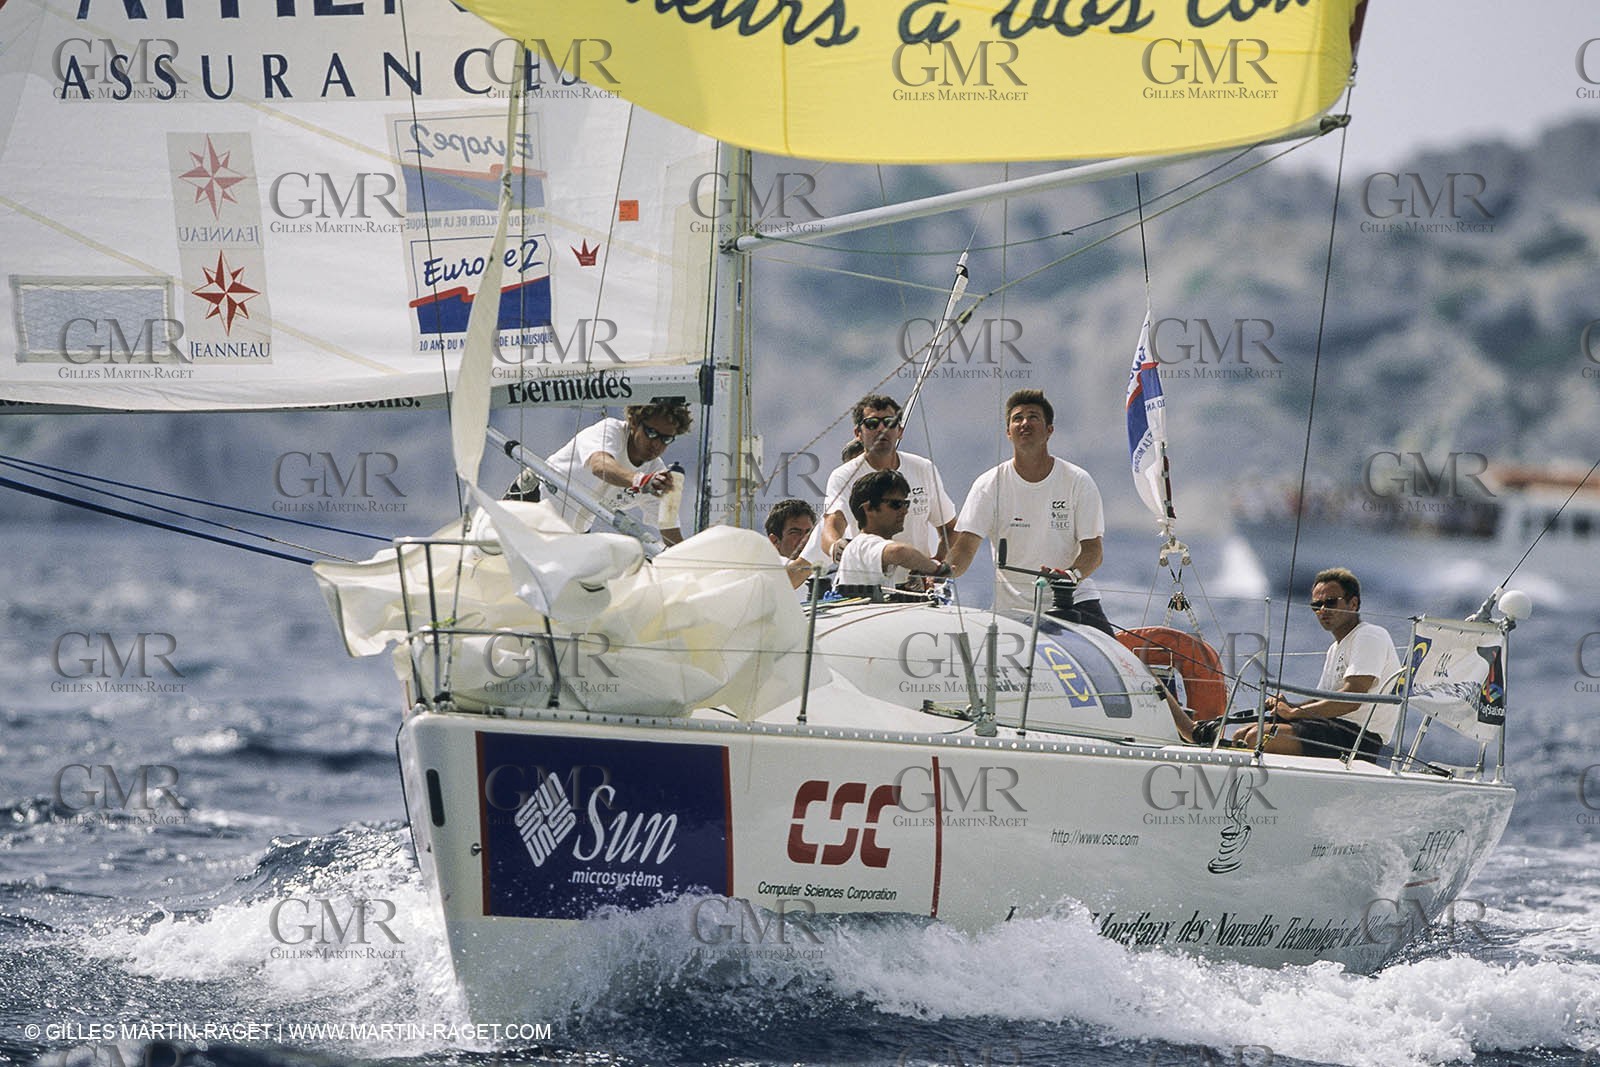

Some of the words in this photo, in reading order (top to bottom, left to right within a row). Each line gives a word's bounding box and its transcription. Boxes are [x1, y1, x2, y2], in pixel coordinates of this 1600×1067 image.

[423, 239, 544, 287] Euroe2
[190, 341, 270, 360] JEANNEAU
[420, 340, 427, 351] 10
[430, 339, 445, 350] ANS
[447, 338, 458, 350] DU
[500, 336, 508, 346] DE
[511, 335, 520, 346] LA
[522, 332, 553, 345] MUSIQUE
[507, 370, 633, 404] Bermudes
[572, 785, 678, 864] Sun
[787, 780, 901, 868] CSC
[1051, 828, 1139, 846] http://www.csc.com
[758, 881, 802, 897] Computer
[804, 884, 844, 899] Sciences
[847, 886, 897, 902] Corporation
[1175, 910, 1211, 944] des
[1204, 912, 1280, 948] Nouvelles
